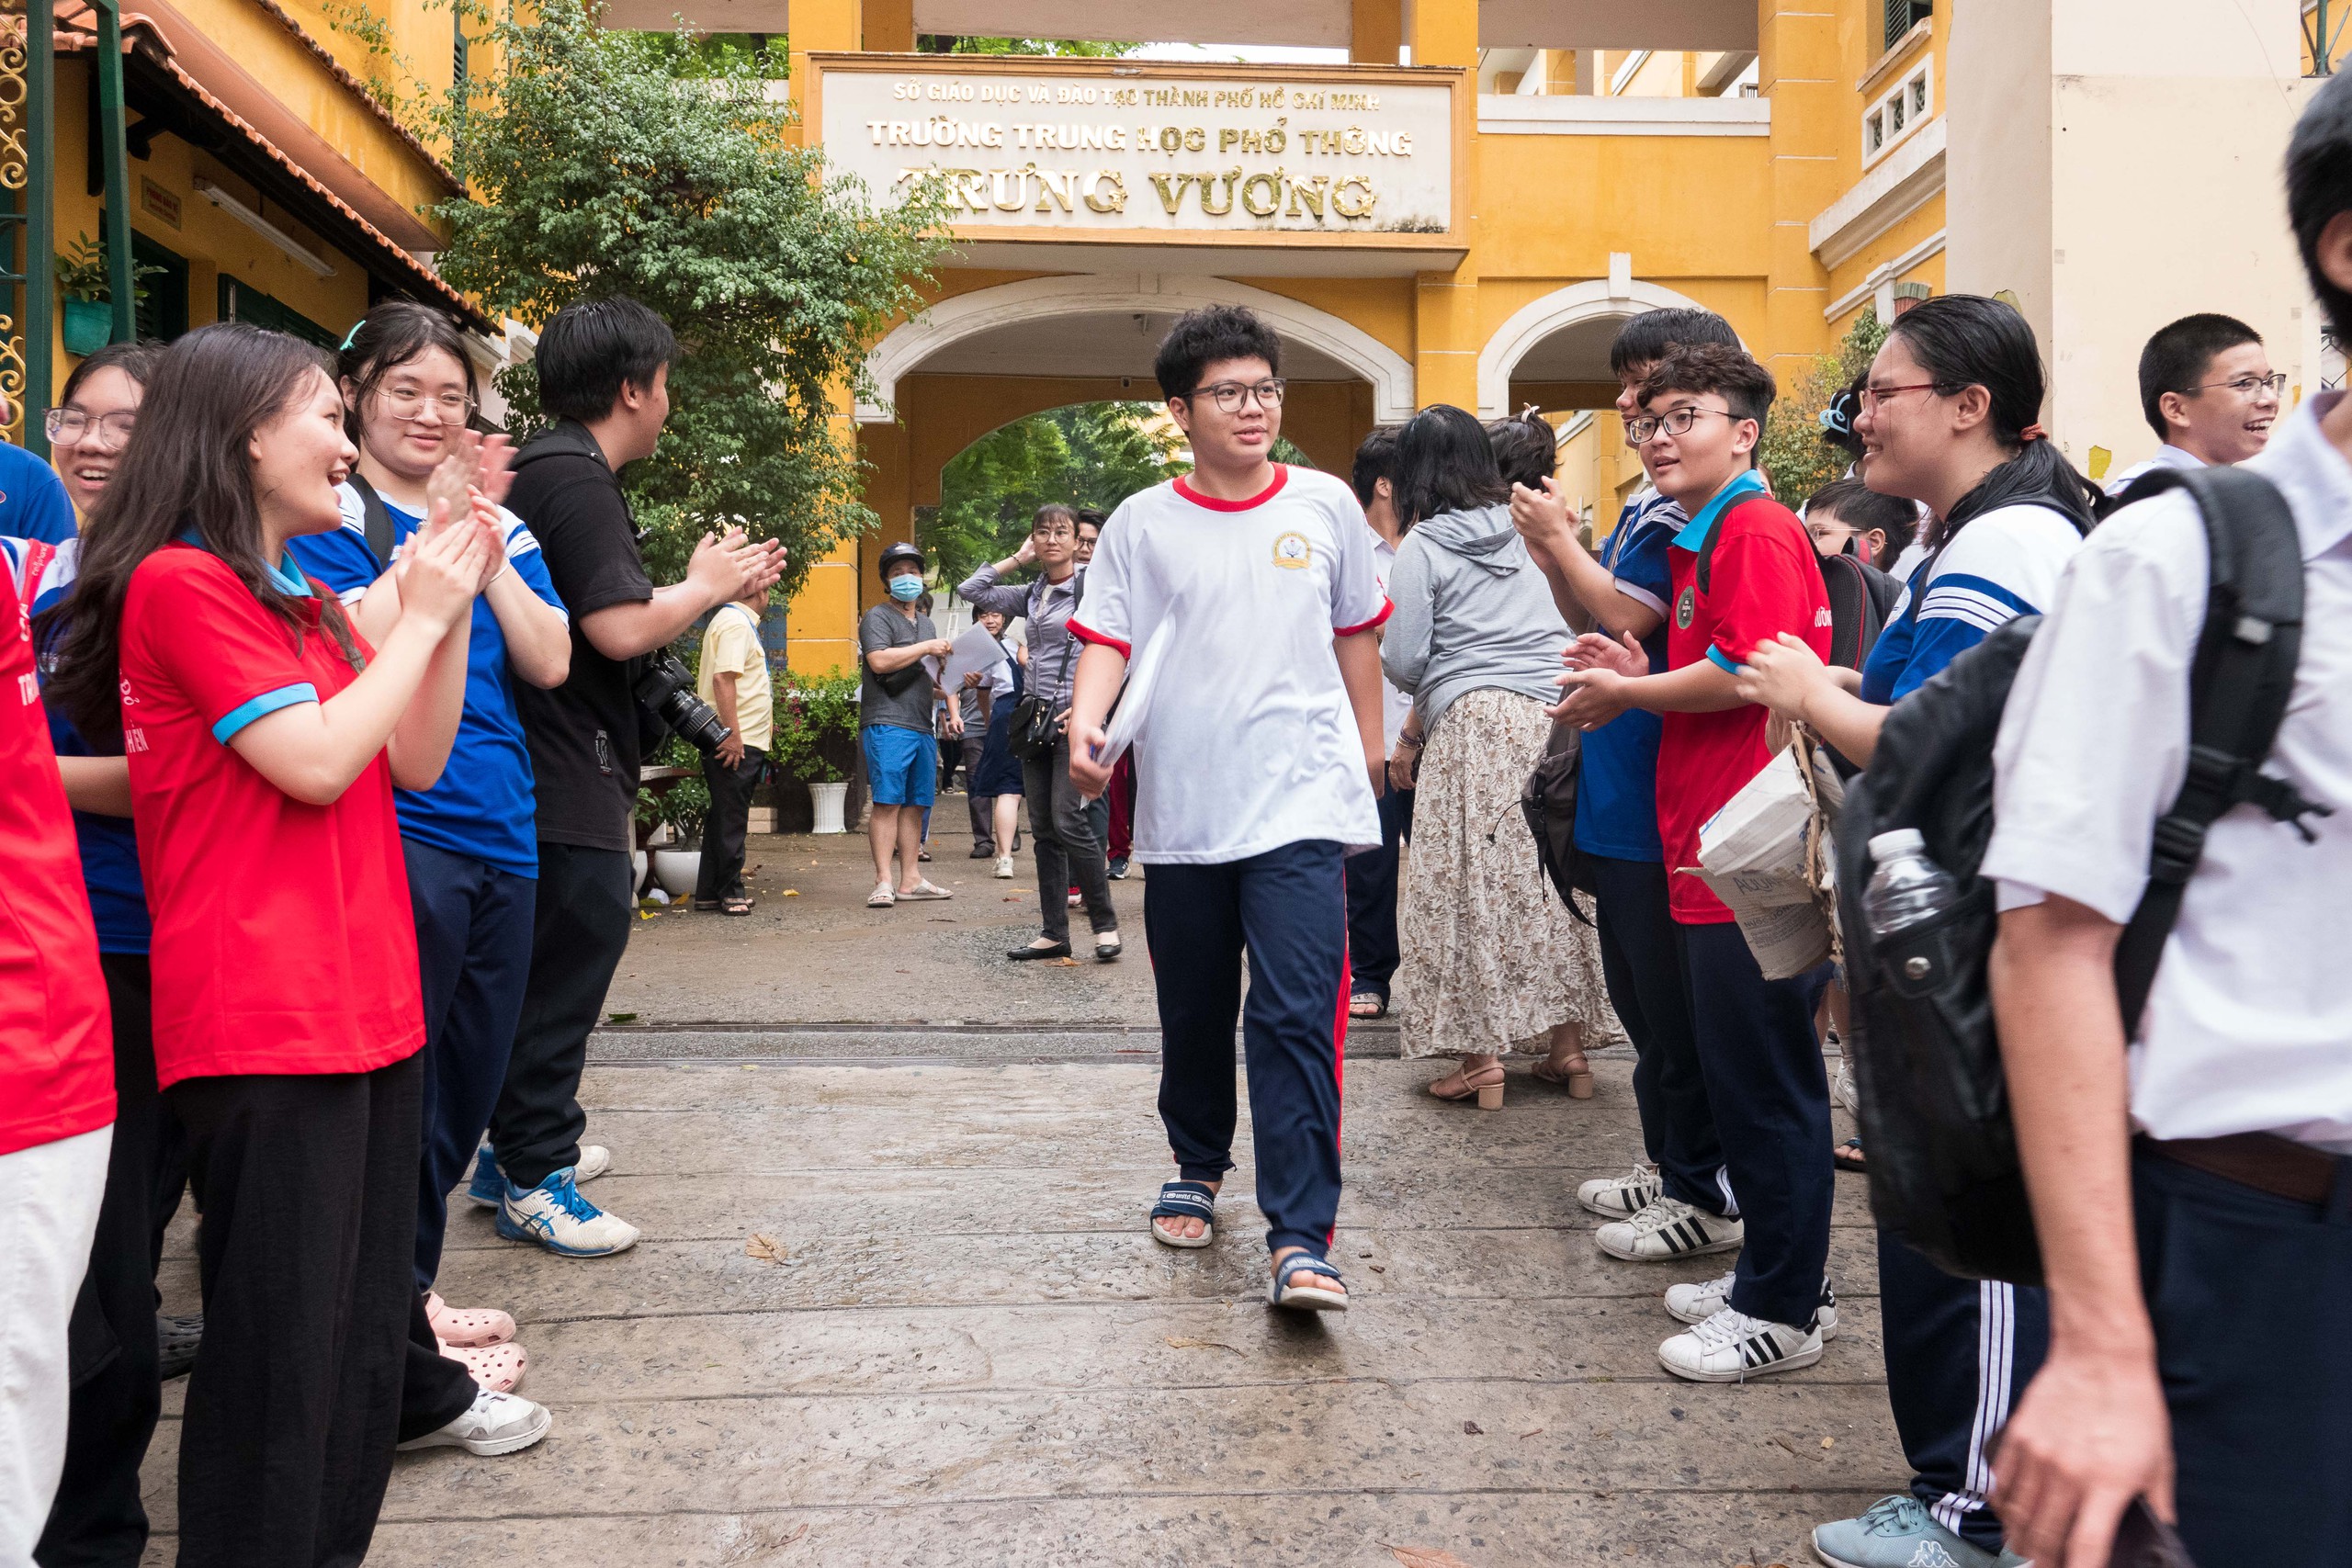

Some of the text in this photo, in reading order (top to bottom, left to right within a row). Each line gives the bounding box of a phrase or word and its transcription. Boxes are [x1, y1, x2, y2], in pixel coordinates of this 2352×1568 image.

[893, 77, 1380, 111] SỞ GIÁO DỤC VÀ ĐÀO TẠO THÀNH PHỐ HỒ CHÍ MINH
[866, 115, 1413, 156] TRƯỜNG TRUNG HỌC PHỔ THÔNG
[897, 162, 1377, 218] TRƯNG VƯƠNG
